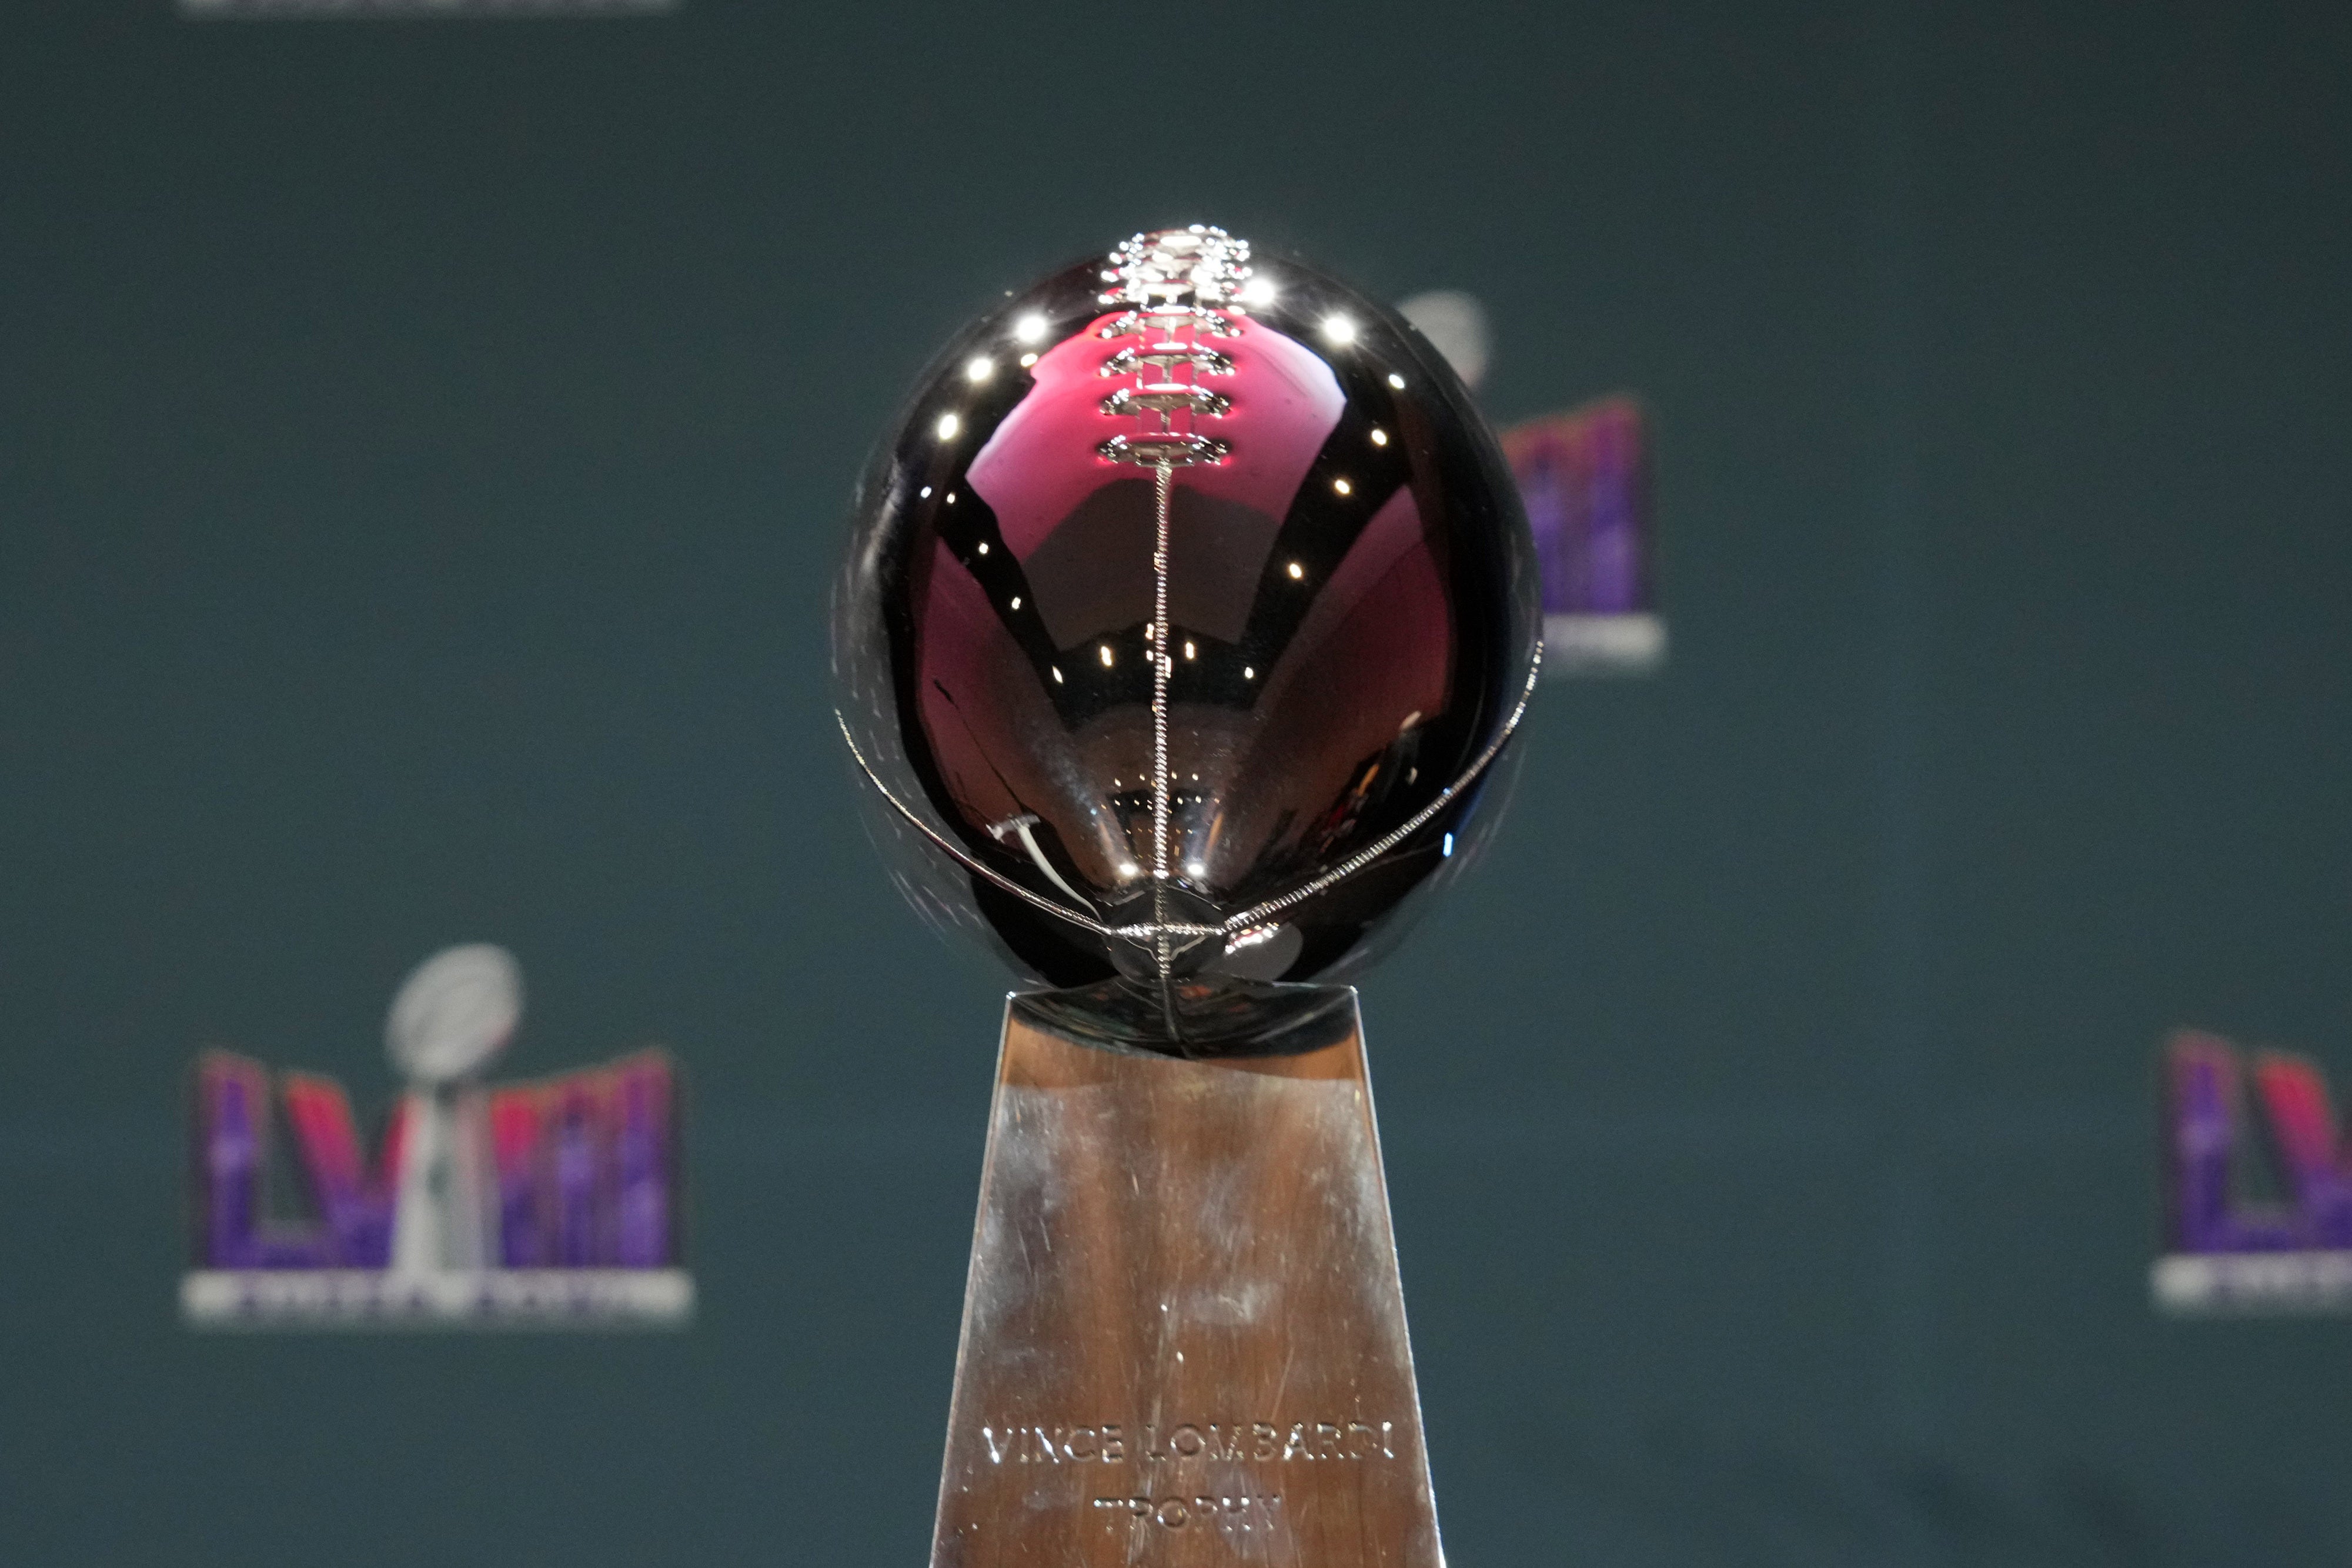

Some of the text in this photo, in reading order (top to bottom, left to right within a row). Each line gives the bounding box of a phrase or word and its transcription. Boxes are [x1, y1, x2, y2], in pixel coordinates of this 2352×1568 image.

[983, 1421, 1394, 1464] VINCE LOMBARDI
[1093, 1495, 1281, 1532] TROPHY
